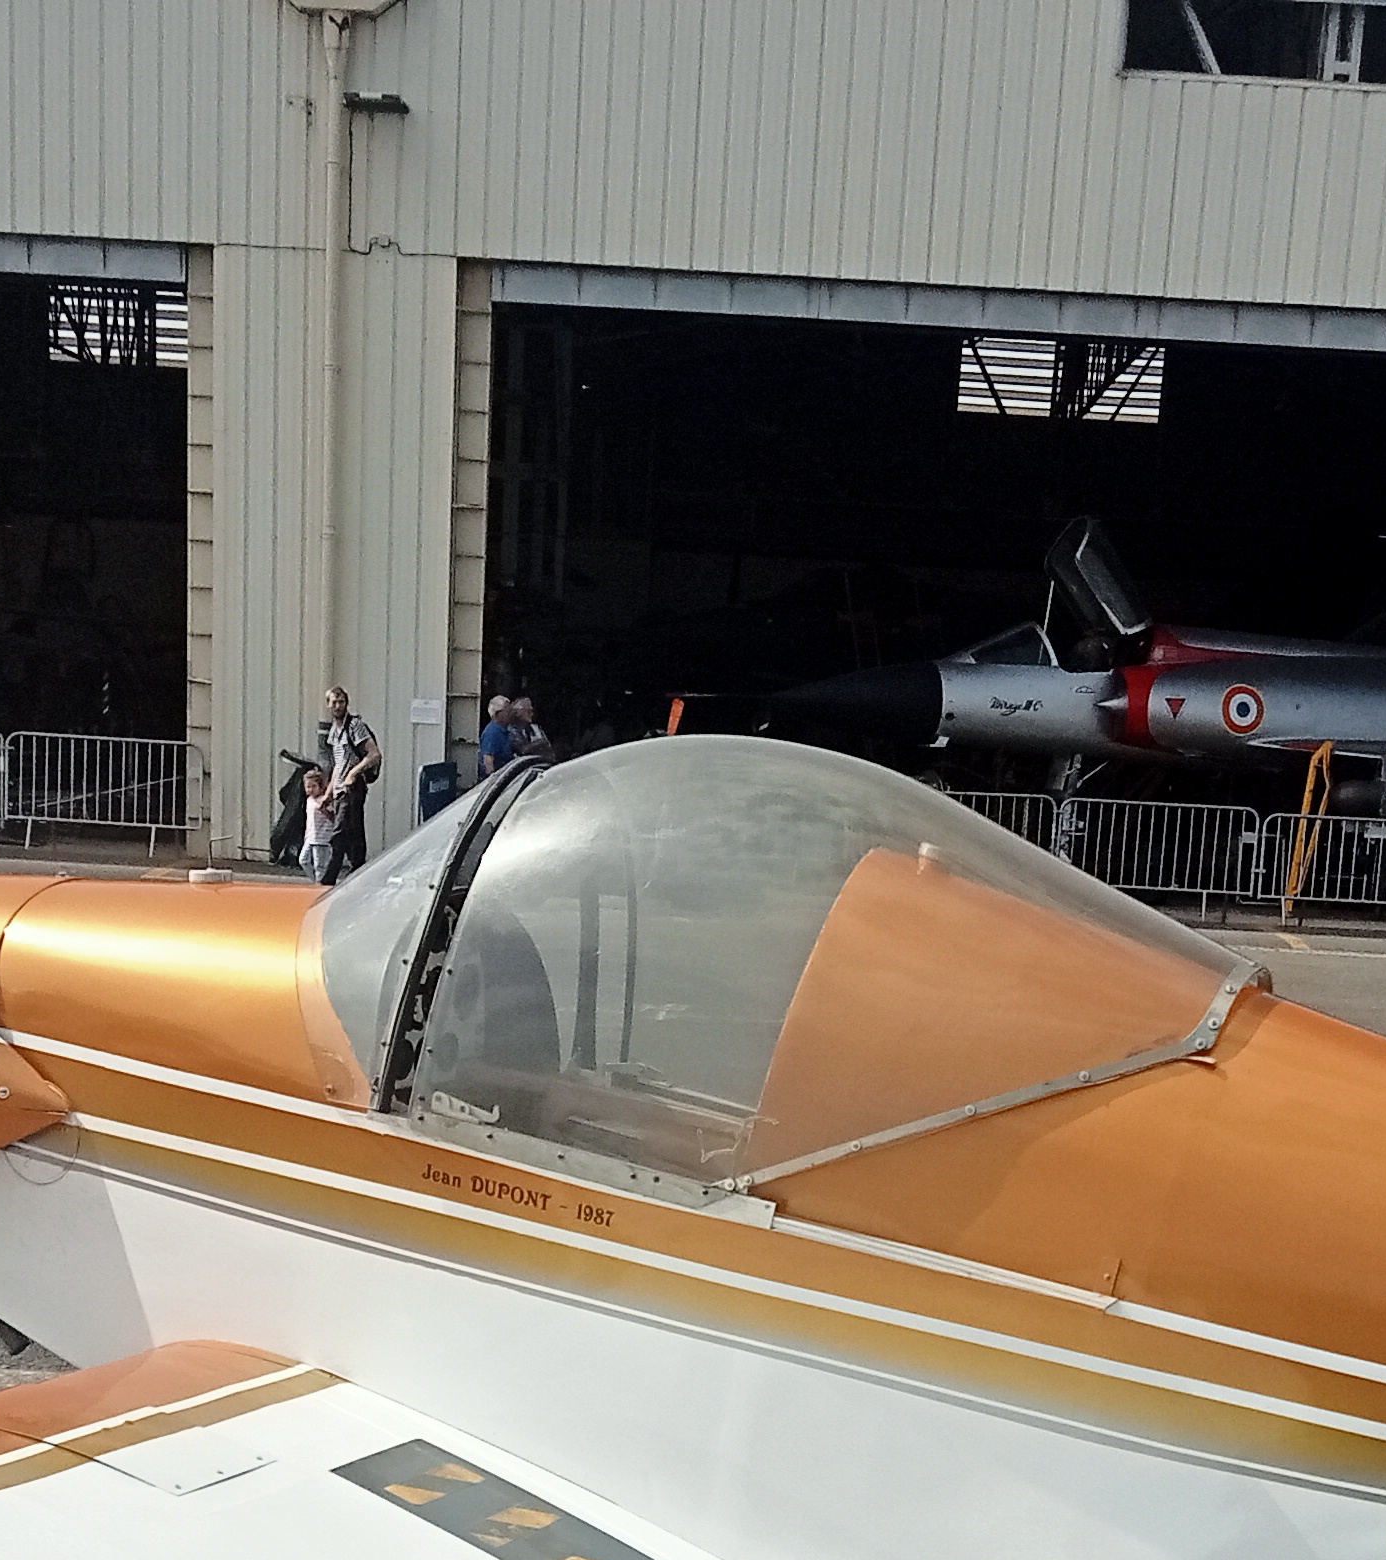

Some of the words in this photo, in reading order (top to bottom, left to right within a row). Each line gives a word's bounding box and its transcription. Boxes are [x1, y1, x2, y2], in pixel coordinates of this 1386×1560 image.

[422, 1164, 462, 1188] Jean
[471, 1176, 551, 1210] DUPONT
[576, 1203, 615, 1227] 1987
